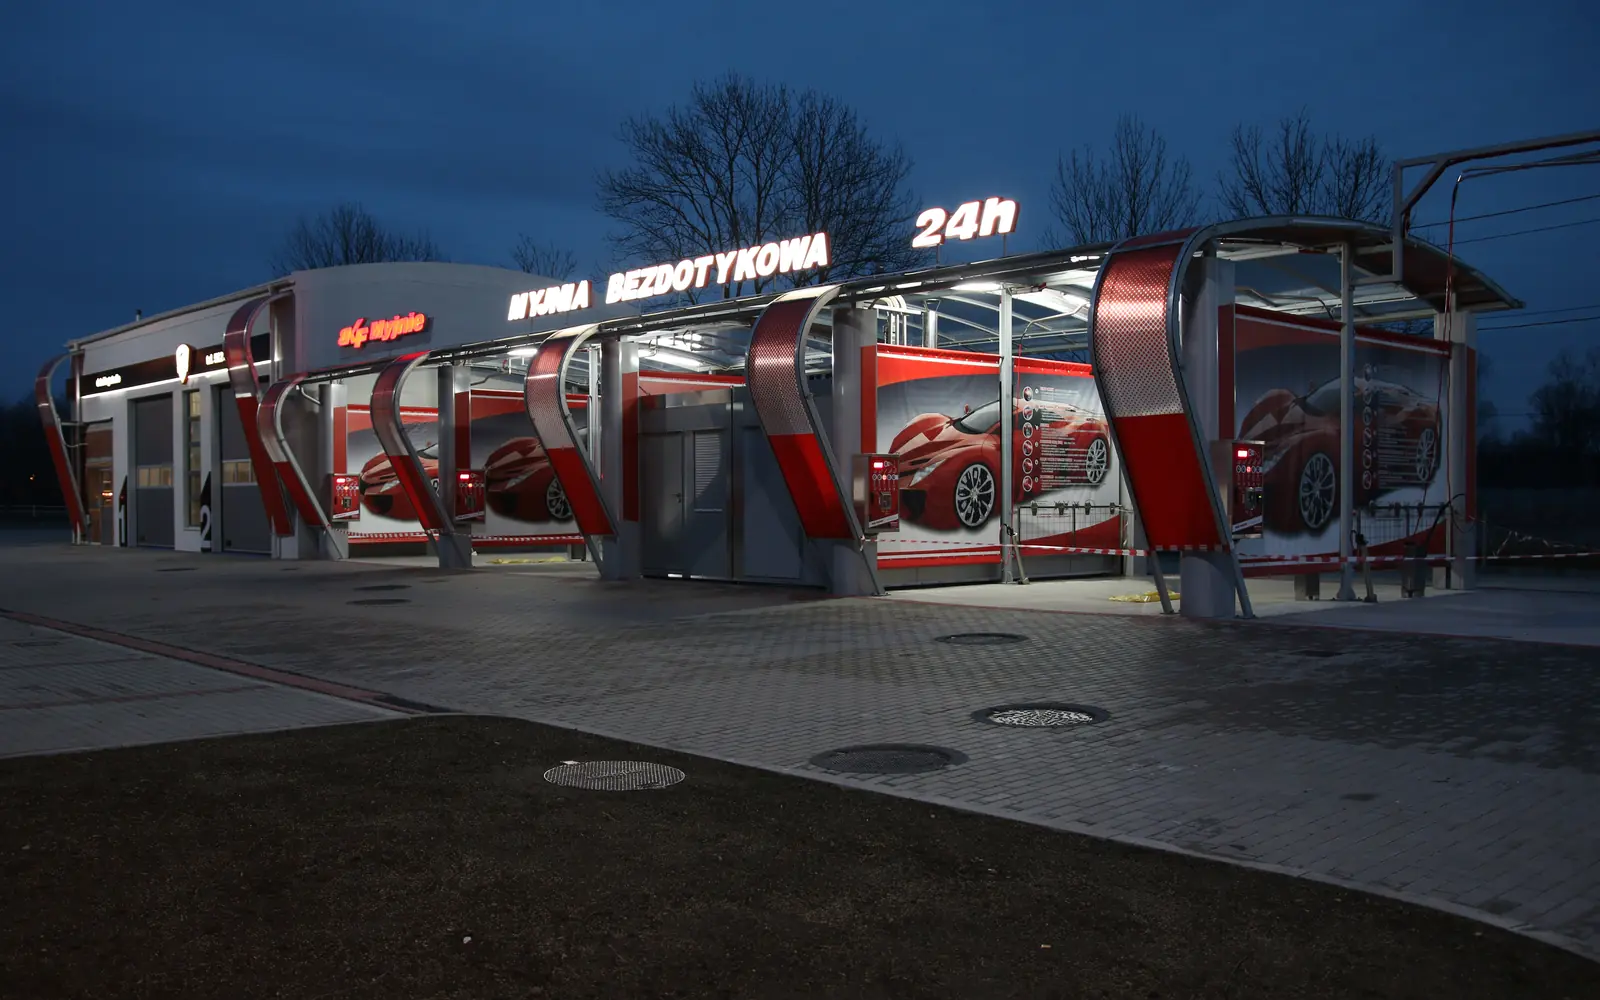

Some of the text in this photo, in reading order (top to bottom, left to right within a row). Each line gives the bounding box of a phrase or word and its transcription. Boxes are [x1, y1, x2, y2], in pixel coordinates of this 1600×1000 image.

[912, 196, 1017, 248] 24h
[605, 233, 829, 304] BEZDOTYKOWA
[118, 504, 126, 544] 1
[200, 504, 212, 548] 2
